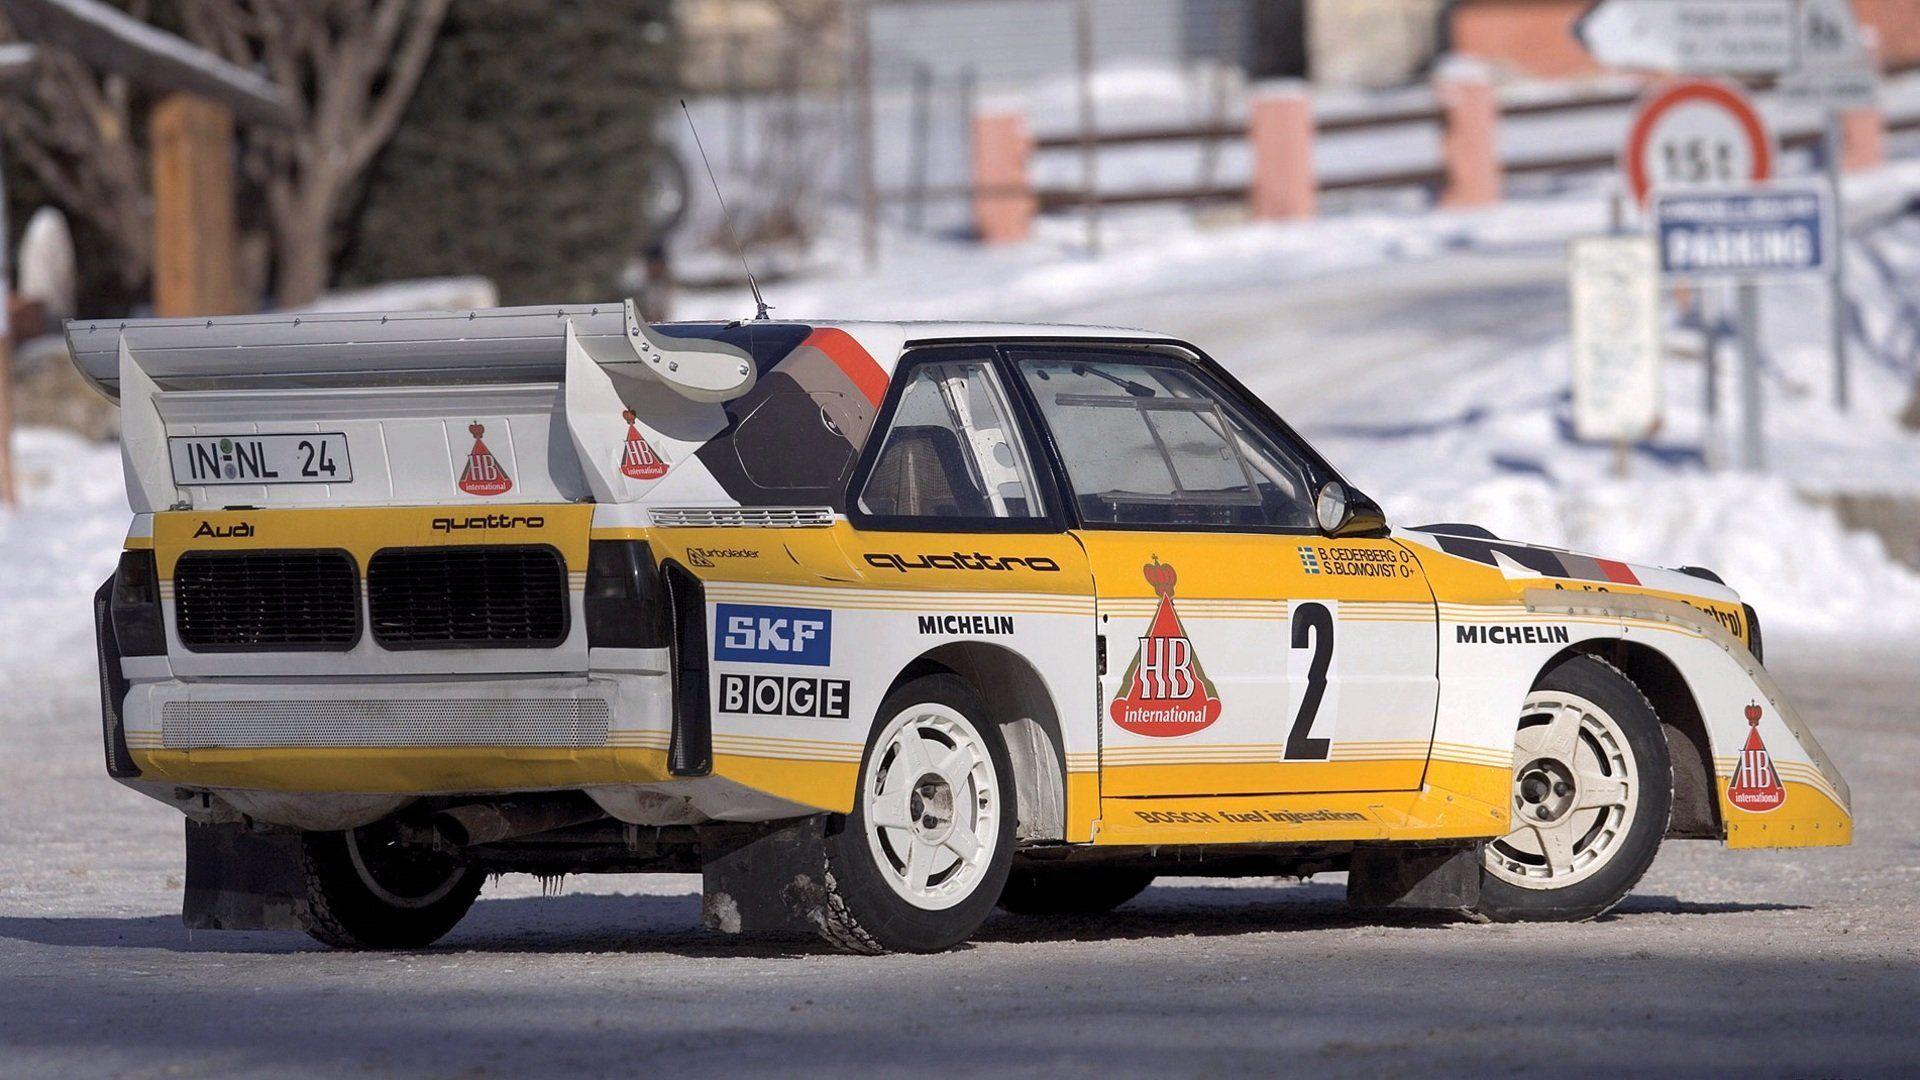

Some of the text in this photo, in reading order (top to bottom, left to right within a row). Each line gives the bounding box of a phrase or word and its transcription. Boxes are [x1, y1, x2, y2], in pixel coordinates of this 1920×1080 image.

[298, 440, 336, 477] 24
[624, 440, 653, 465] HB
[468, 454, 498, 482] HB
[627, 466, 664, 475] international
[465, 482, 507, 491] international
[192, 520, 255, 538] Audi
[432, 514, 545, 533] quattro
[695, 547, 760, 559] Turbolader
[863, 551, 1061, 573] quattro
[918, 615, 1015, 636] MICHELIN
[1681, 600, 1742, 638] trol
[724, 615, 824, 653] SKF
[1456, 624, 1570, 645] MICHELIN
[1138, 636, 1196, 701] HB
[1283, 602, 1334, 760] 2
[724, 677, 847, 718] BOGE
[1124, 704, 1207, 724] international
[1740, 749, 1772, 788] HB
[1735, 792, 1779, 803] international
[1134, 810, 1369, 826] BOSCH fuel injection
